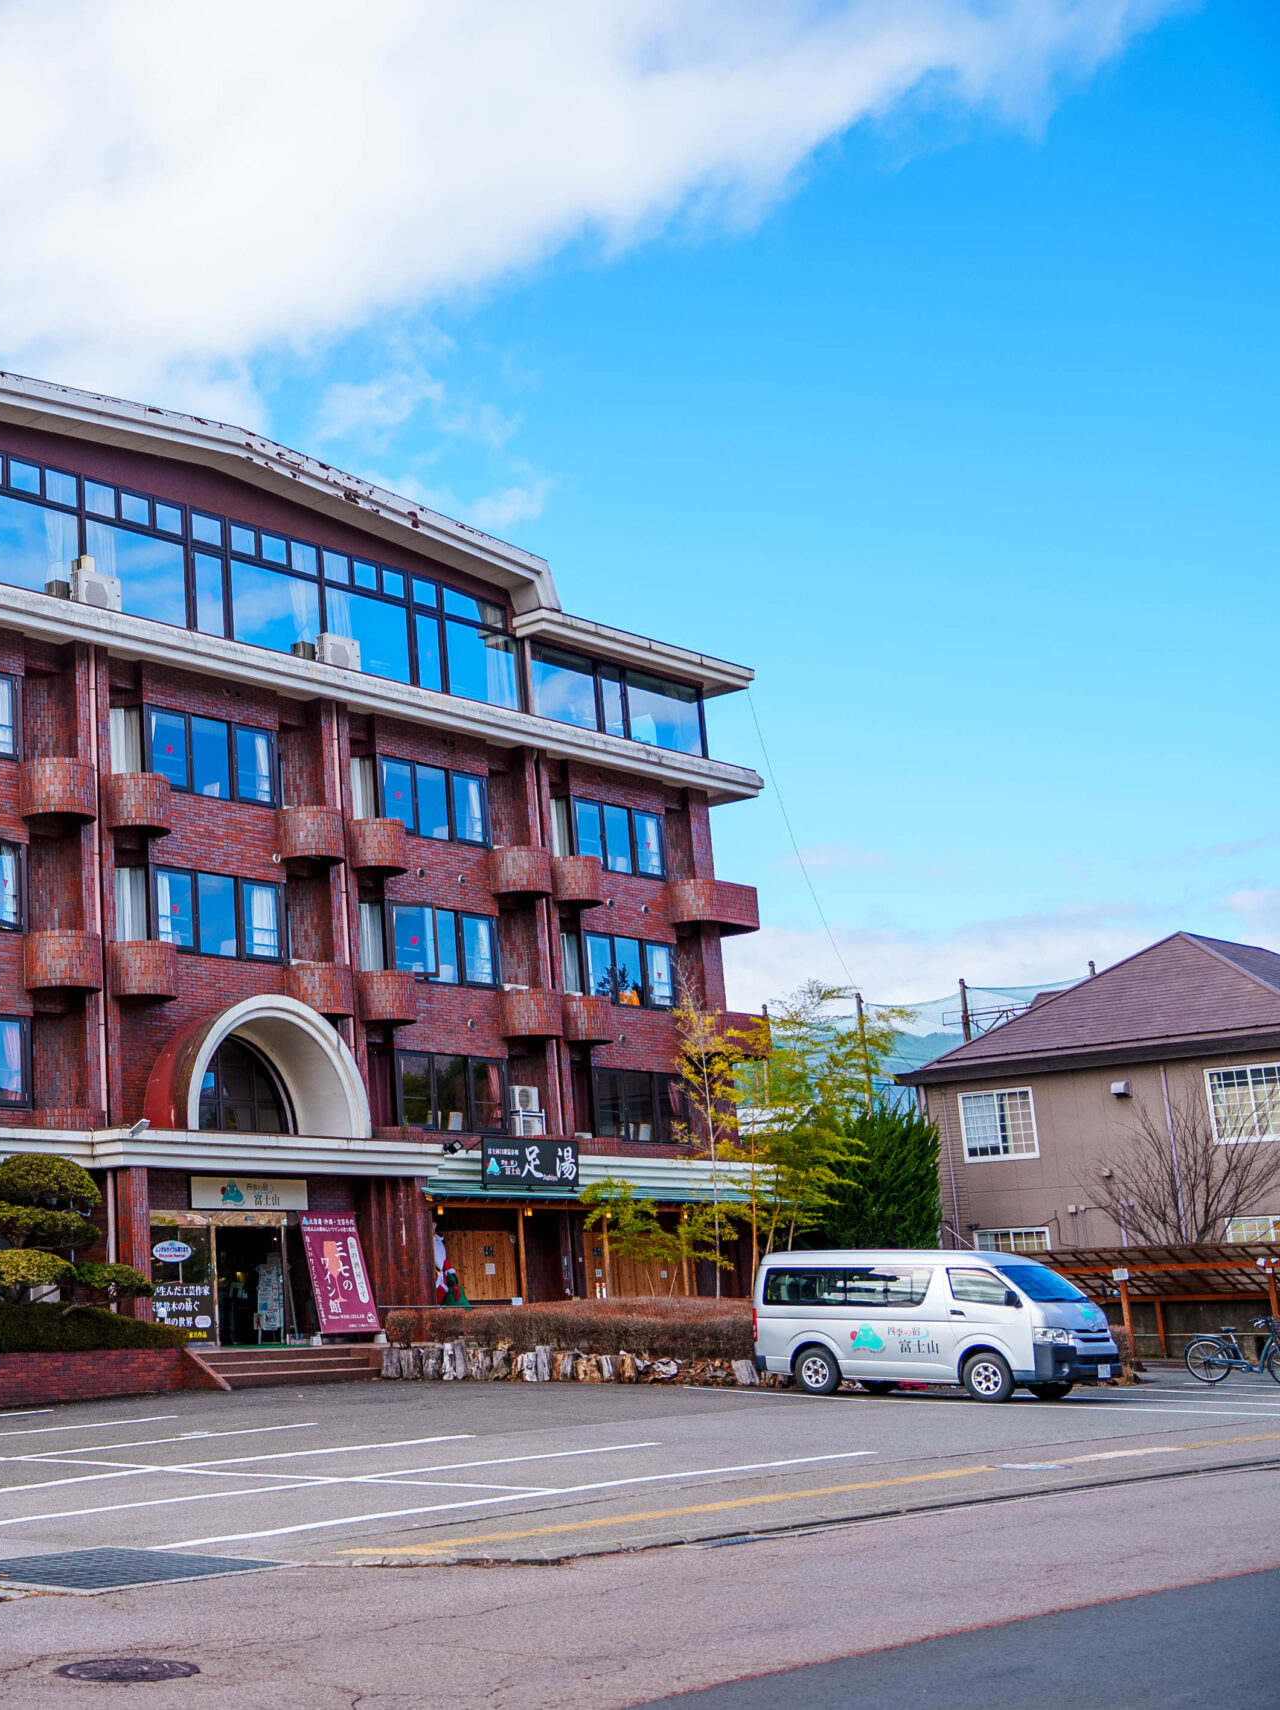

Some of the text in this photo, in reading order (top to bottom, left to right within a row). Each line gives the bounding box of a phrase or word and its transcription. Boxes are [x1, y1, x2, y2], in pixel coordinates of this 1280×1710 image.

[521, 1145, 577, 1180] 足湯
[254, 1194, 280, 1206] 富士山
[335, 1241, 353, 1291] 三七の
[321, 1257, 342, 1313] ワイン館
[887, 1326, 921, 1337] 四季の宿
[899, 1339, 939, 1354] 富士山
